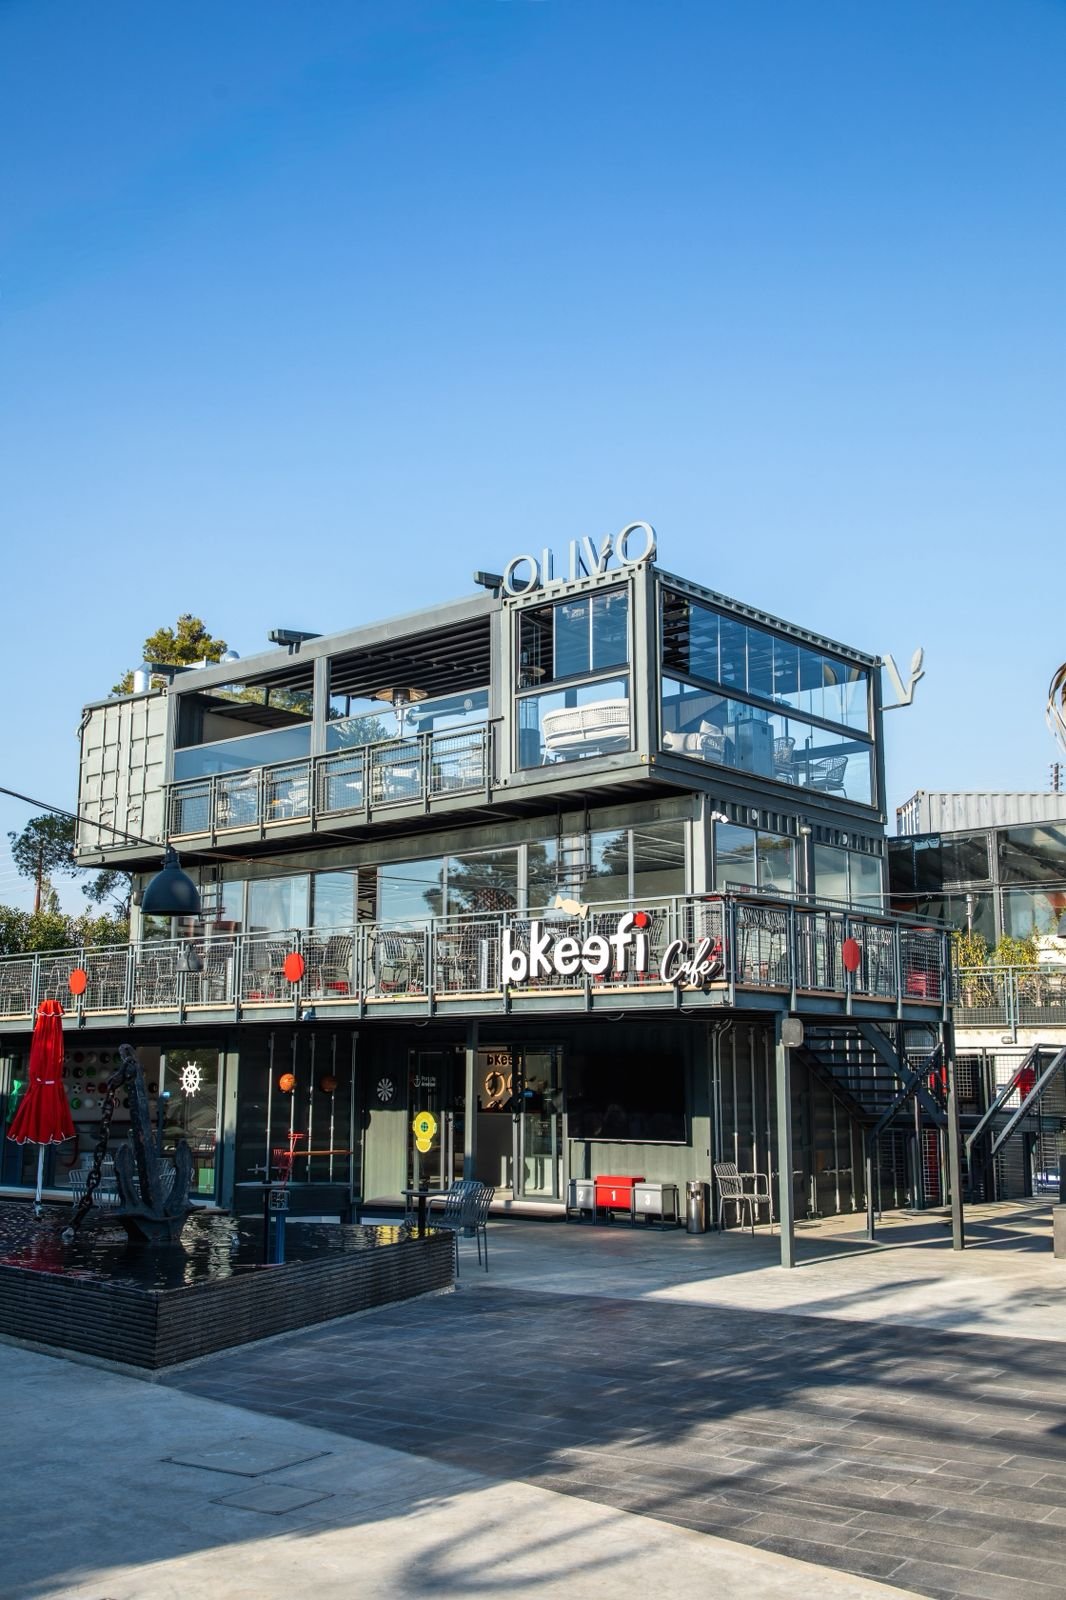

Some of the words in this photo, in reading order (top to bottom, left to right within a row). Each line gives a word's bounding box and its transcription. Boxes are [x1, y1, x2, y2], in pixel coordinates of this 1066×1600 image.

[503, 521, 657, 596] OLIVO
[578, 1190, 584, 1201] 2
[611, 1190, 616, 1201] 1
[645, 1194, 651, 1205] 3
